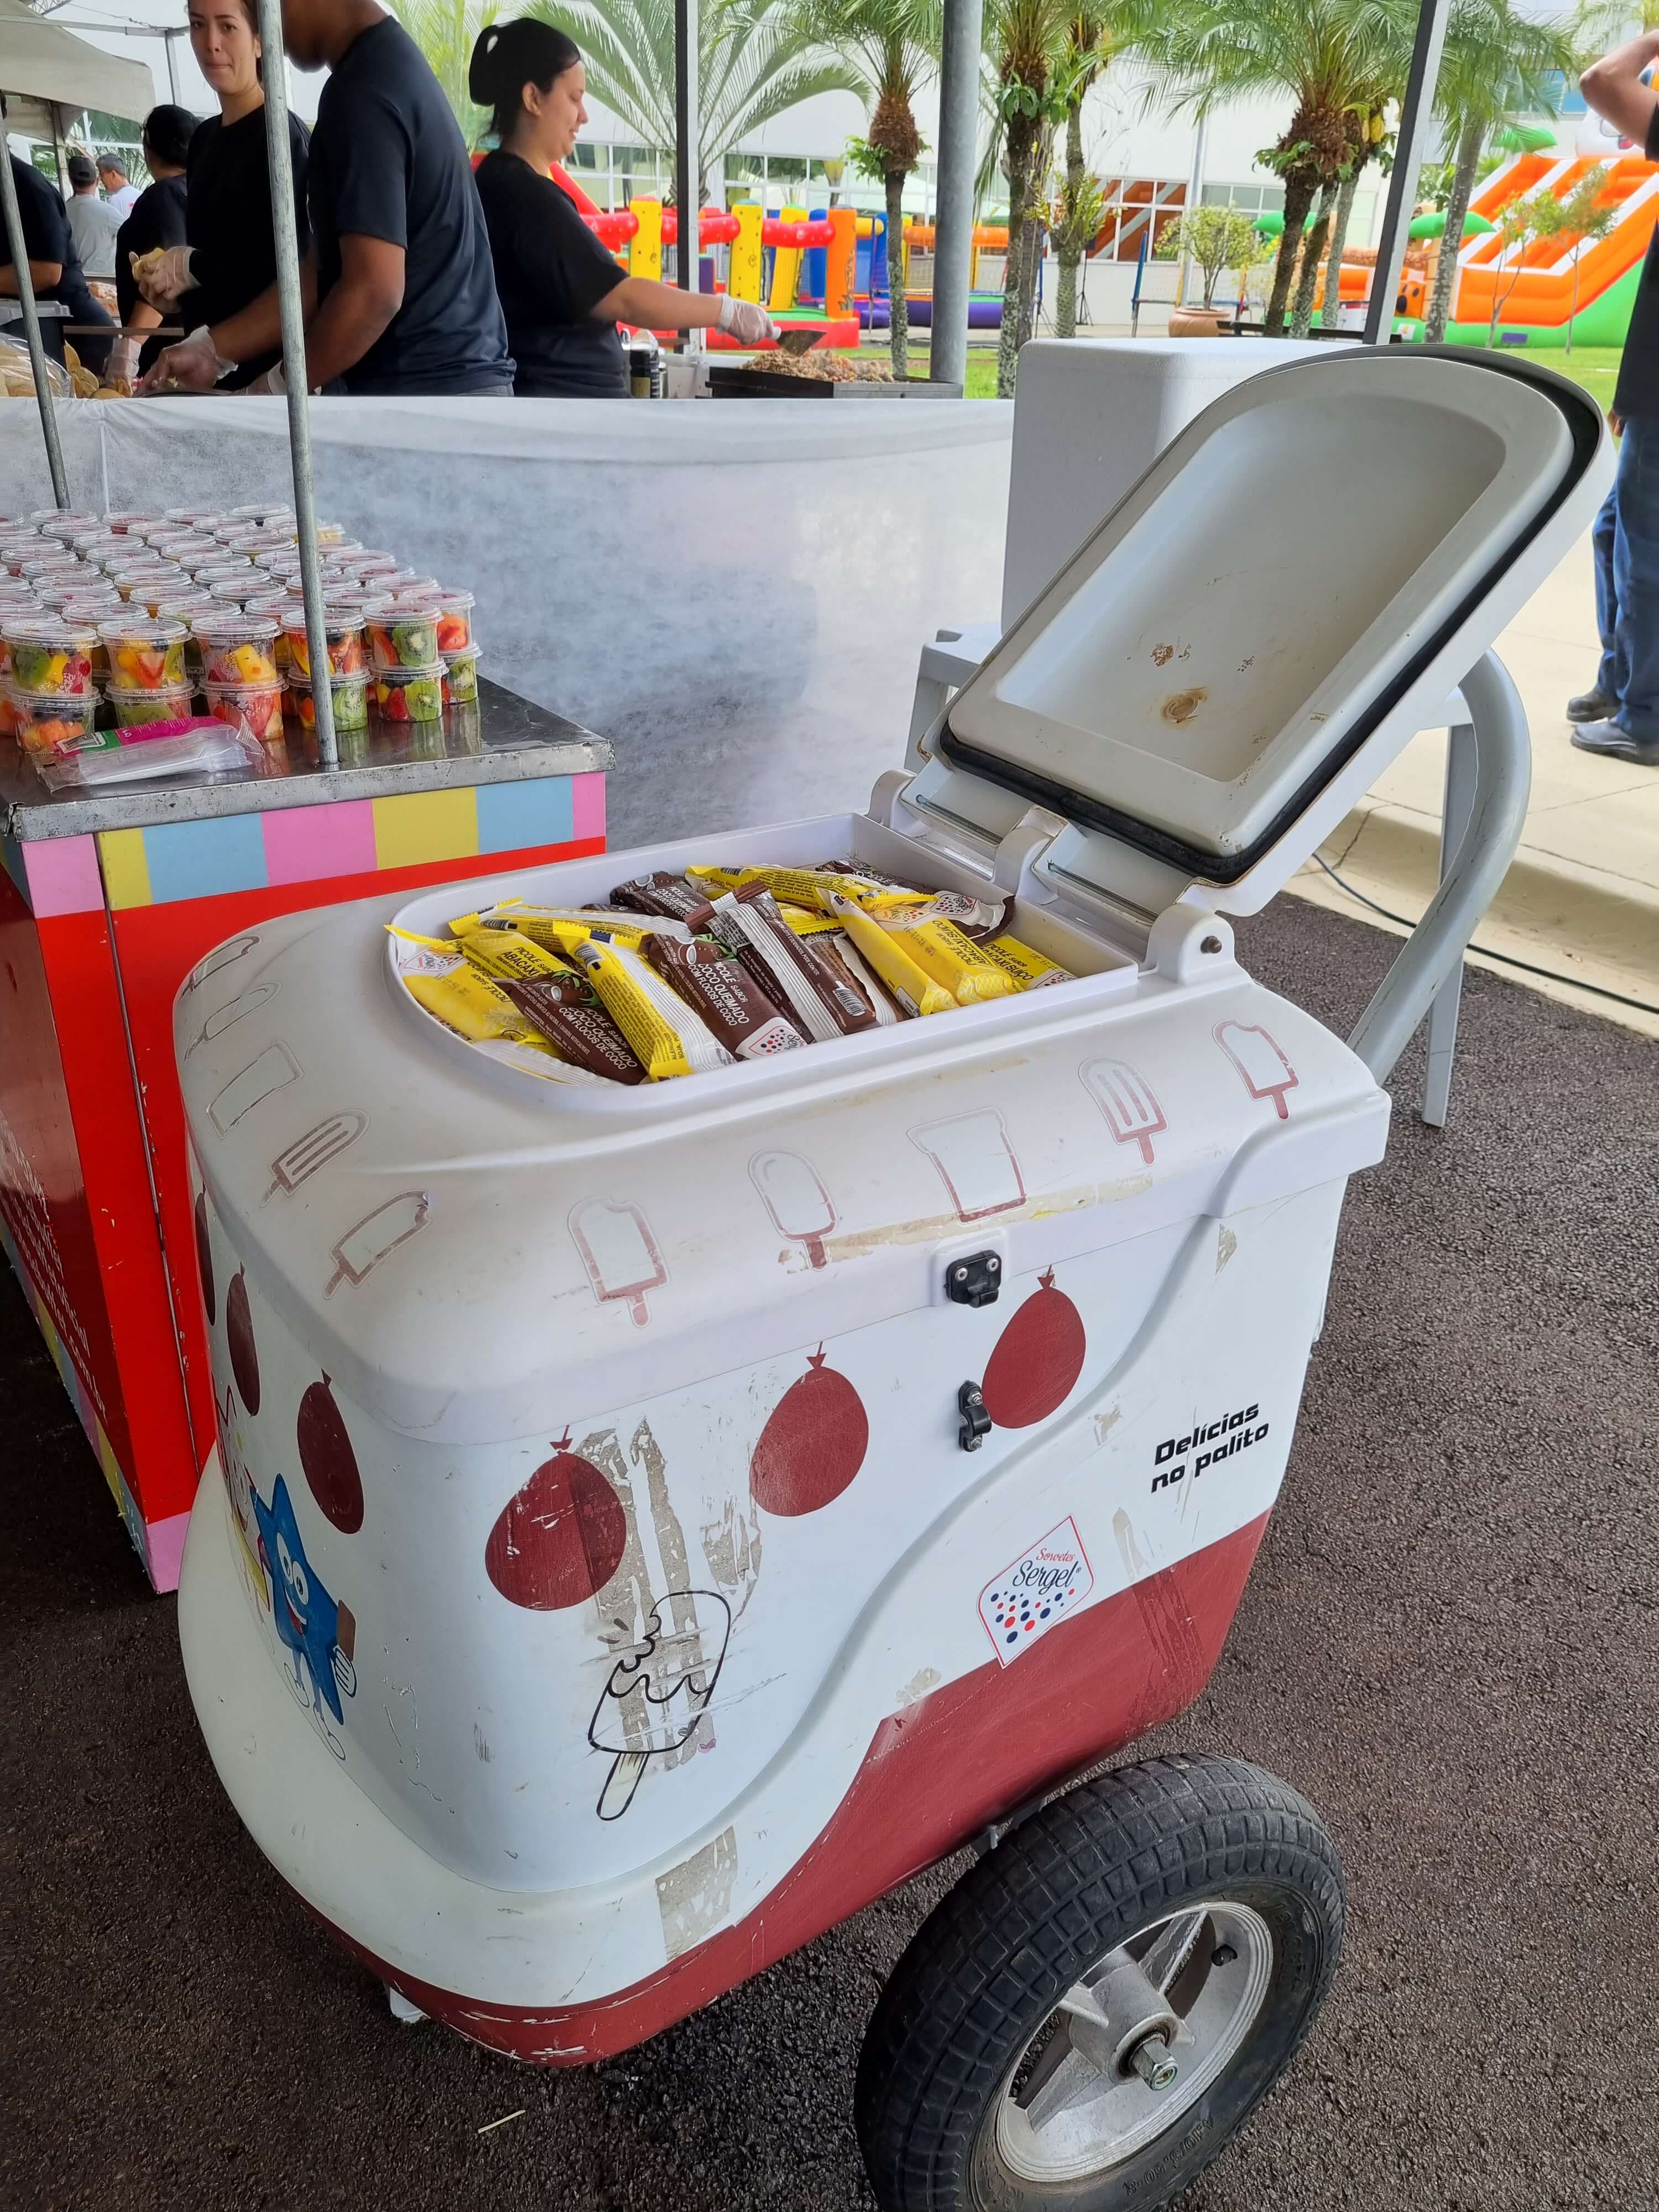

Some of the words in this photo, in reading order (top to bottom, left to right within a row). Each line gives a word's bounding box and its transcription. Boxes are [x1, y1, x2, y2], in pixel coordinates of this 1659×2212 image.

[500, 951, 540, 977] ABACAXI
[514, 947, 545, 964] PICOLÉ
[688, 965, 702, 978] COM
[697, 977, 719, 1000] FLOCOS
[713, 999, 726, 1009] DE
[720, 1008, 737, 1026] COCO
[698, 964, 720, 983] COCO
[714, 984, 750, 1024] QUEIMADO
[731, 985, 748, 1003] SABOR
[559, 1008, 576, 1022] COM
[572, 1020, 599, 1044] FLOCOS
[596, 1043, 609, 1052] DE
[606, 1051, 627, 1070] COCO
[568, 1008, 596, 1027] COCO
[593, 1029, 638, 1067] QUEIMADO
[1151, 1464, 1185, 1494] no
[1194, 1423, 1269, 1478] palito
[1154, 1402, 1259, 1465] Delícias
[1036, 1548, 1076, 1562] Sorvetes
